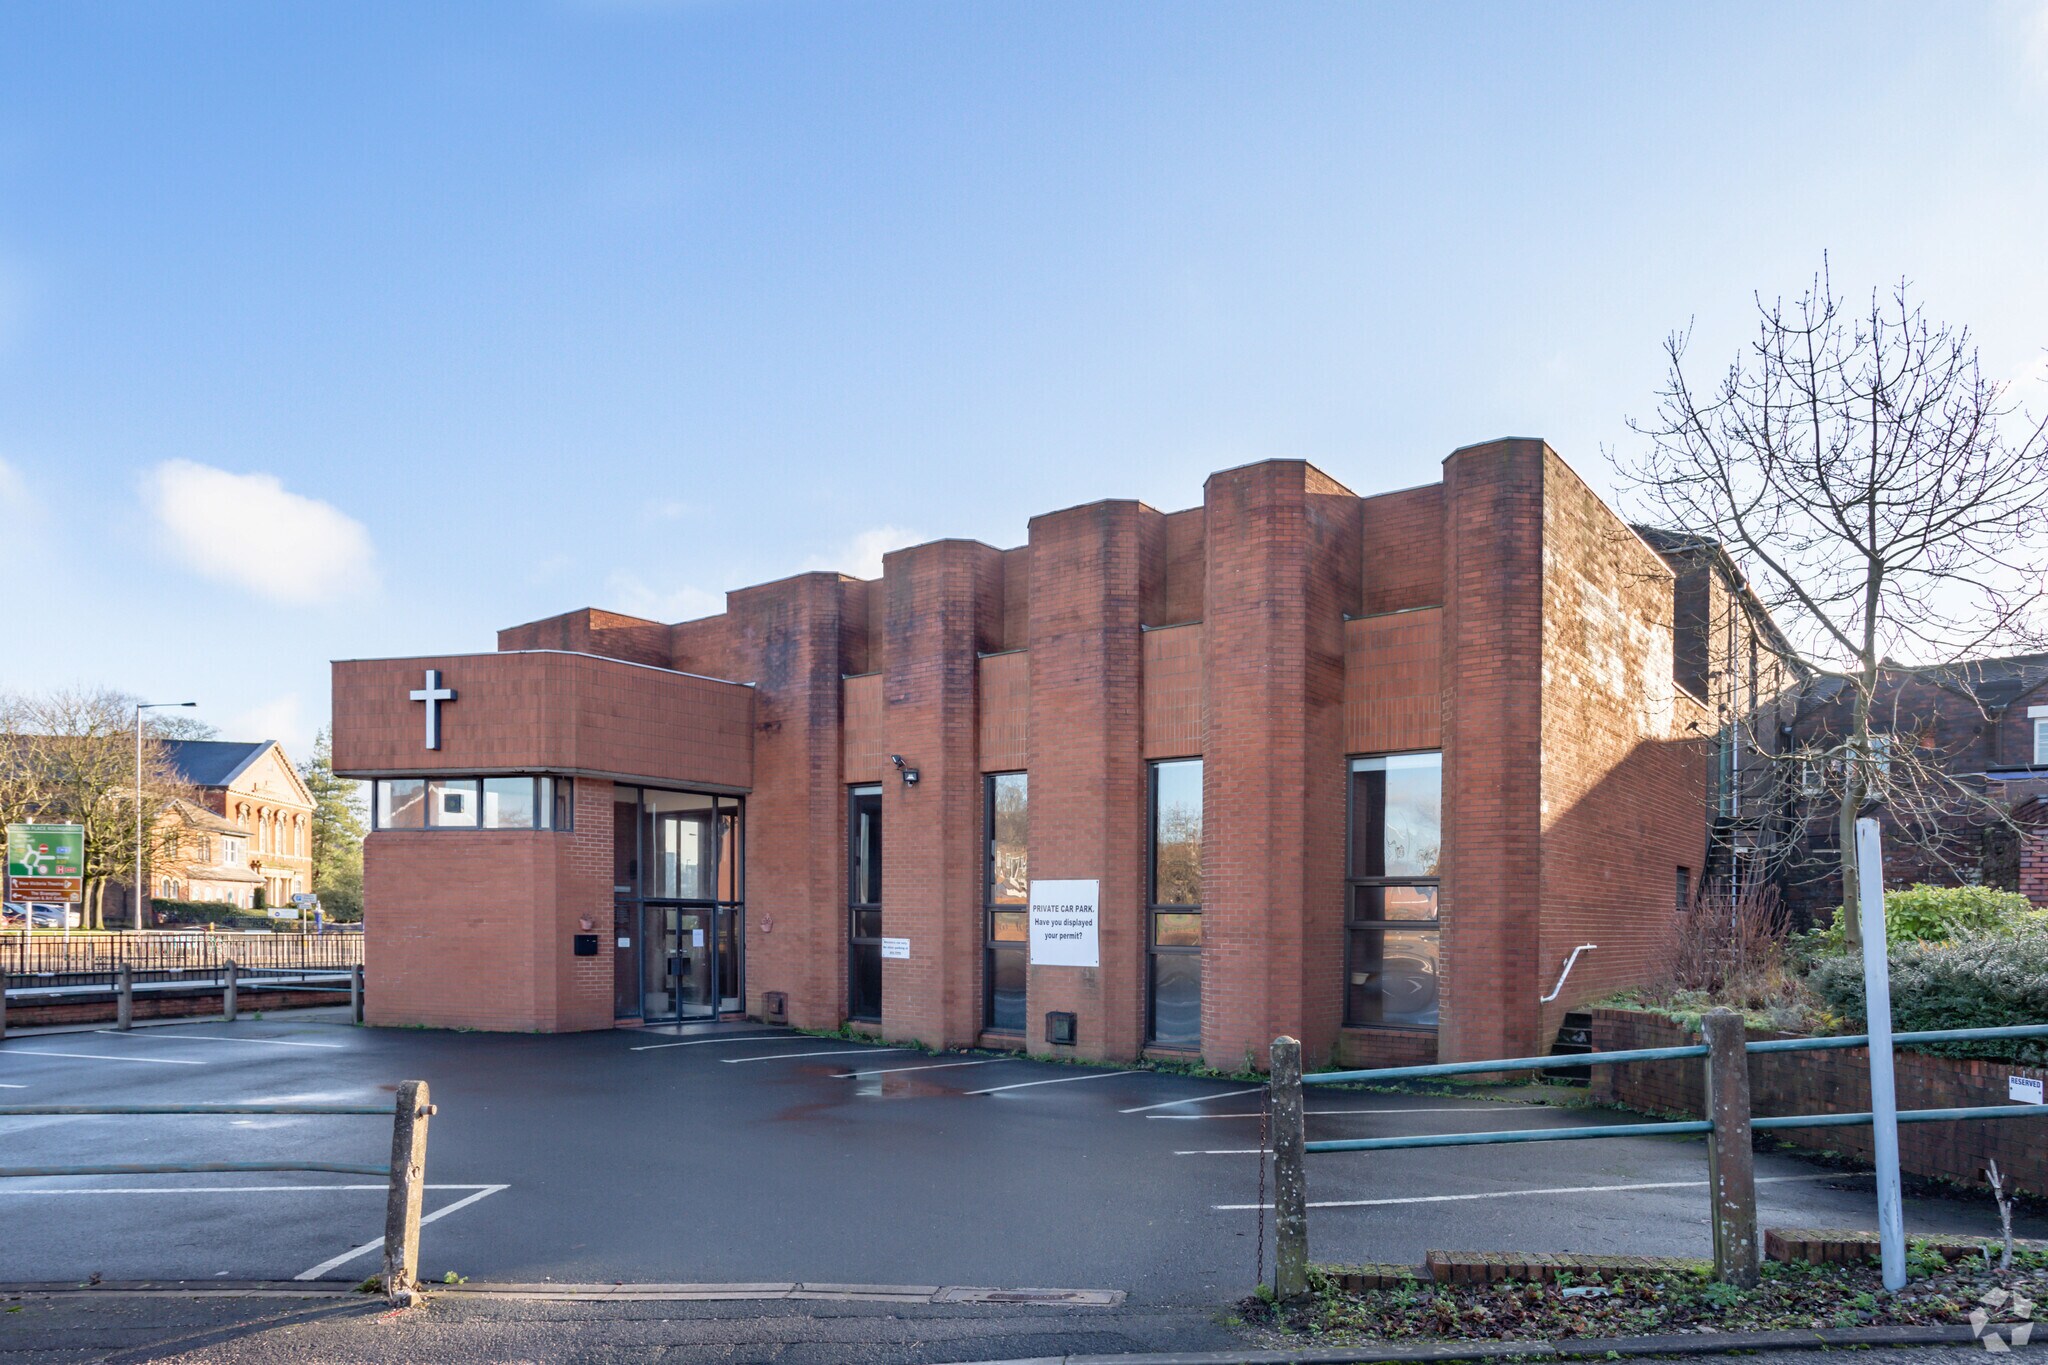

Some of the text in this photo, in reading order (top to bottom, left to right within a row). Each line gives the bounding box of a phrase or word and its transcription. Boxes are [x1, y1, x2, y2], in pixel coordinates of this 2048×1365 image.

[1064, 918, 1092, 928] displayed
[1059, 932, 1083, 940] permit?
[2011, 1077, 2041, 1088] RESERVED
